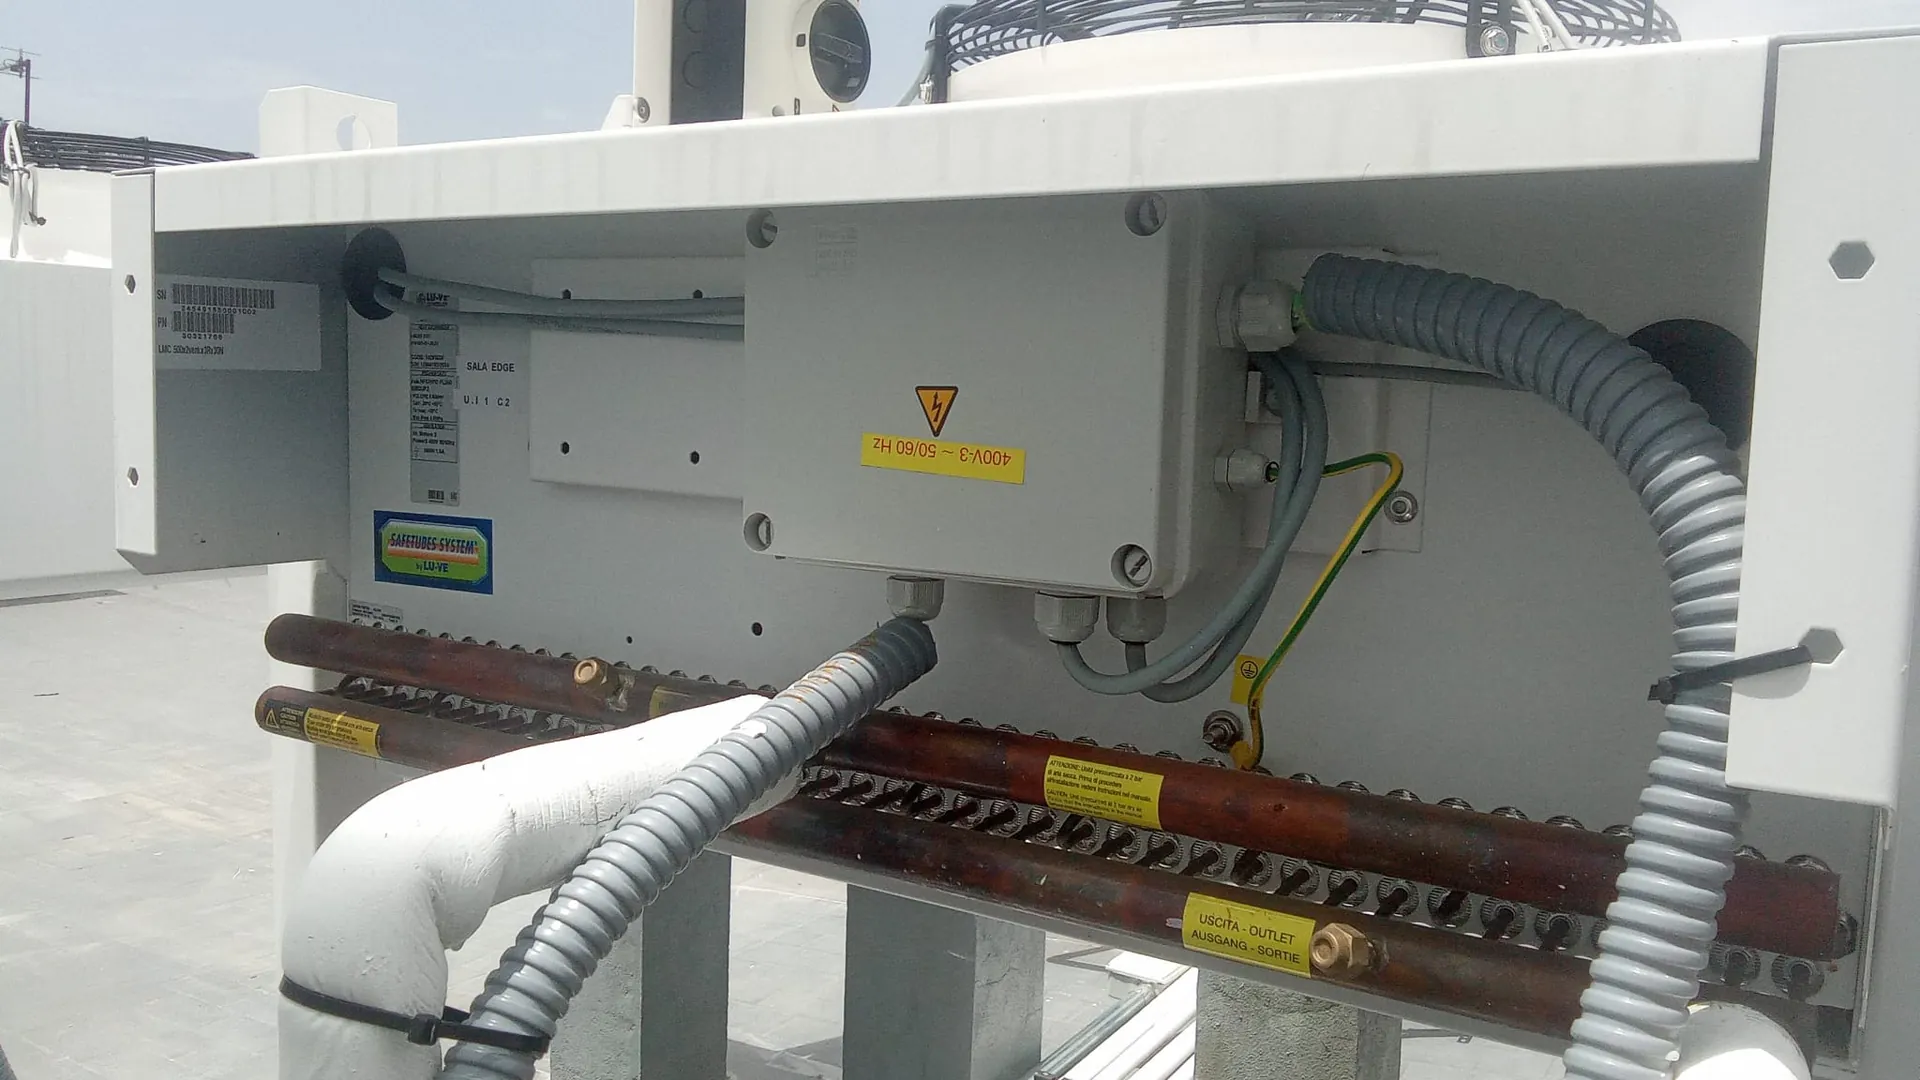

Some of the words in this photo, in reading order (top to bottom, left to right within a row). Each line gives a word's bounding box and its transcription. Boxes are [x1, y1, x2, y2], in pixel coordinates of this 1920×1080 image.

[157, 289, 167, 300] SN
[157, 317, 167, 328] PN
[466, 362, 488, 371] SALA
[491, 362, 515, 373] EDGE
[497, 397, 510, 407] C2
[873, 437, 892, 454] Hz
[896, 440, 937, 458] 50/60
[390, 533, 437, 551] SAFETUBES
[423, 560, 448, 573] LU-VE
[1199, 913, 1239, 932] USCITA
[1249, 925, 1295, 945] OUTLET
[1191, 929, 1247, 951] AUSGANG
[1257, 945, 1301, 964] SORTIE
